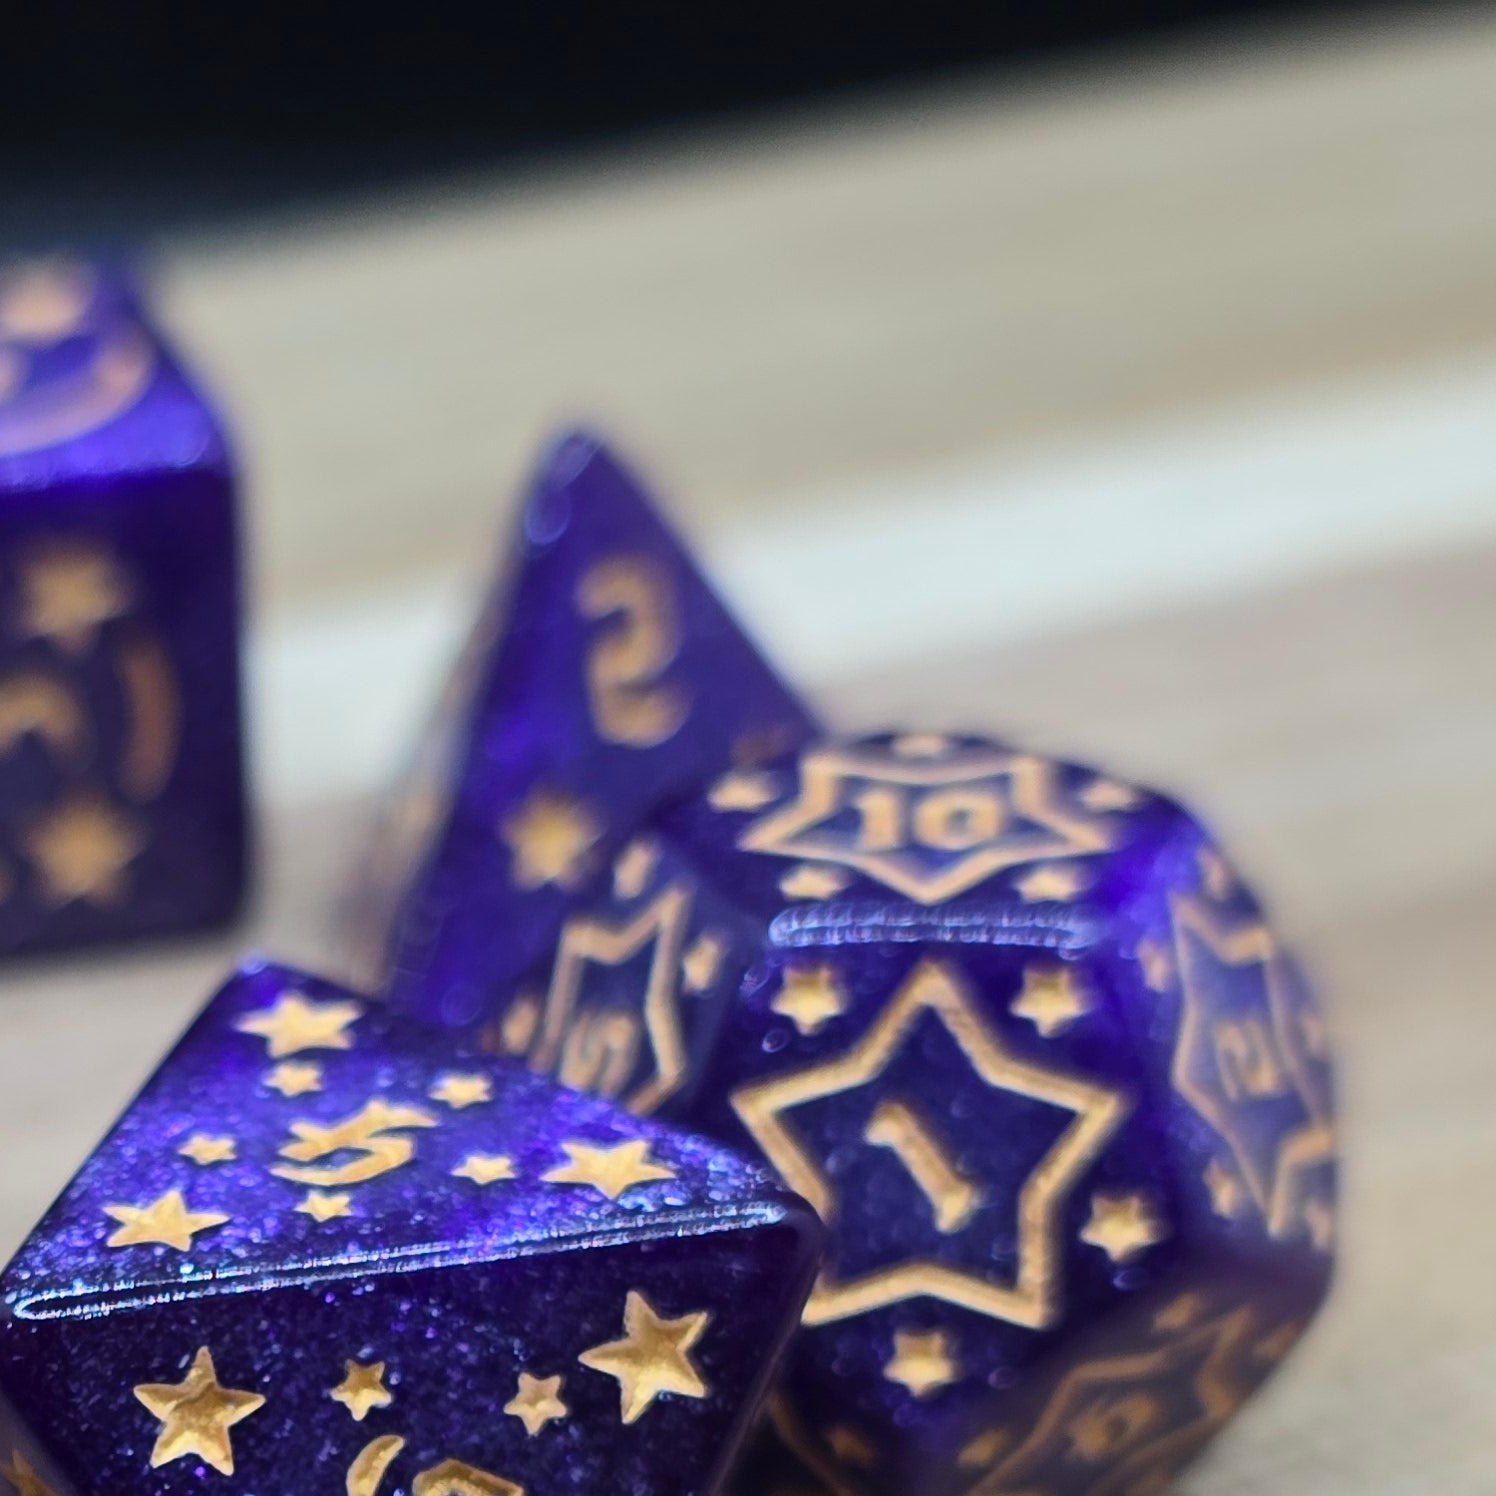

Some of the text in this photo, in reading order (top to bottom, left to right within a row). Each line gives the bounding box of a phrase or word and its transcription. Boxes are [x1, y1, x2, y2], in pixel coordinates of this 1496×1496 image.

[578, 557, 690, 748] 2
[854, 787, 1004, 851] 10
[866, 1102, 978, 1236] 1
